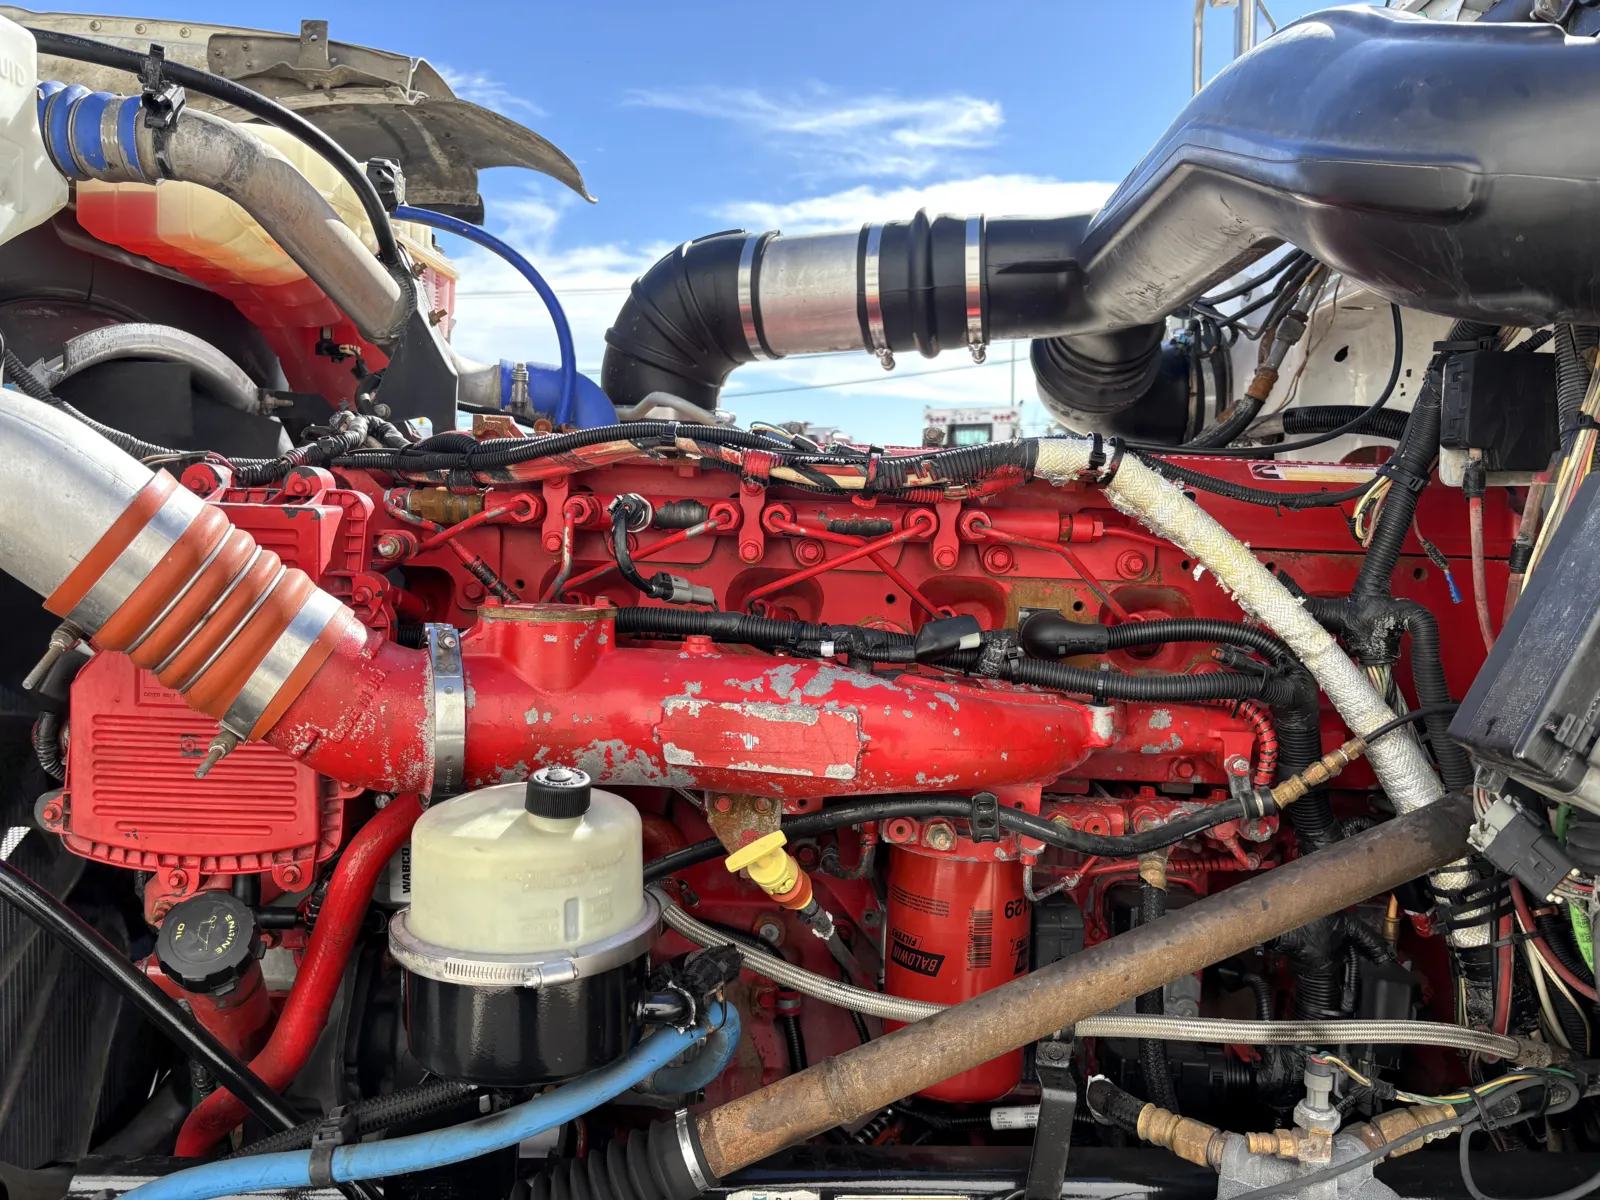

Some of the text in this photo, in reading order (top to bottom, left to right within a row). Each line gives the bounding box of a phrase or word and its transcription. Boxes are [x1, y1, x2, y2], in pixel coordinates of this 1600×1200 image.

[402, 847, 411, 894] WABCO
[175, 914, 235, 954] ENGINE OIL
[891, 928, 917, 947] FILTERS
[892, 944, 938, 972] BALDWIN
